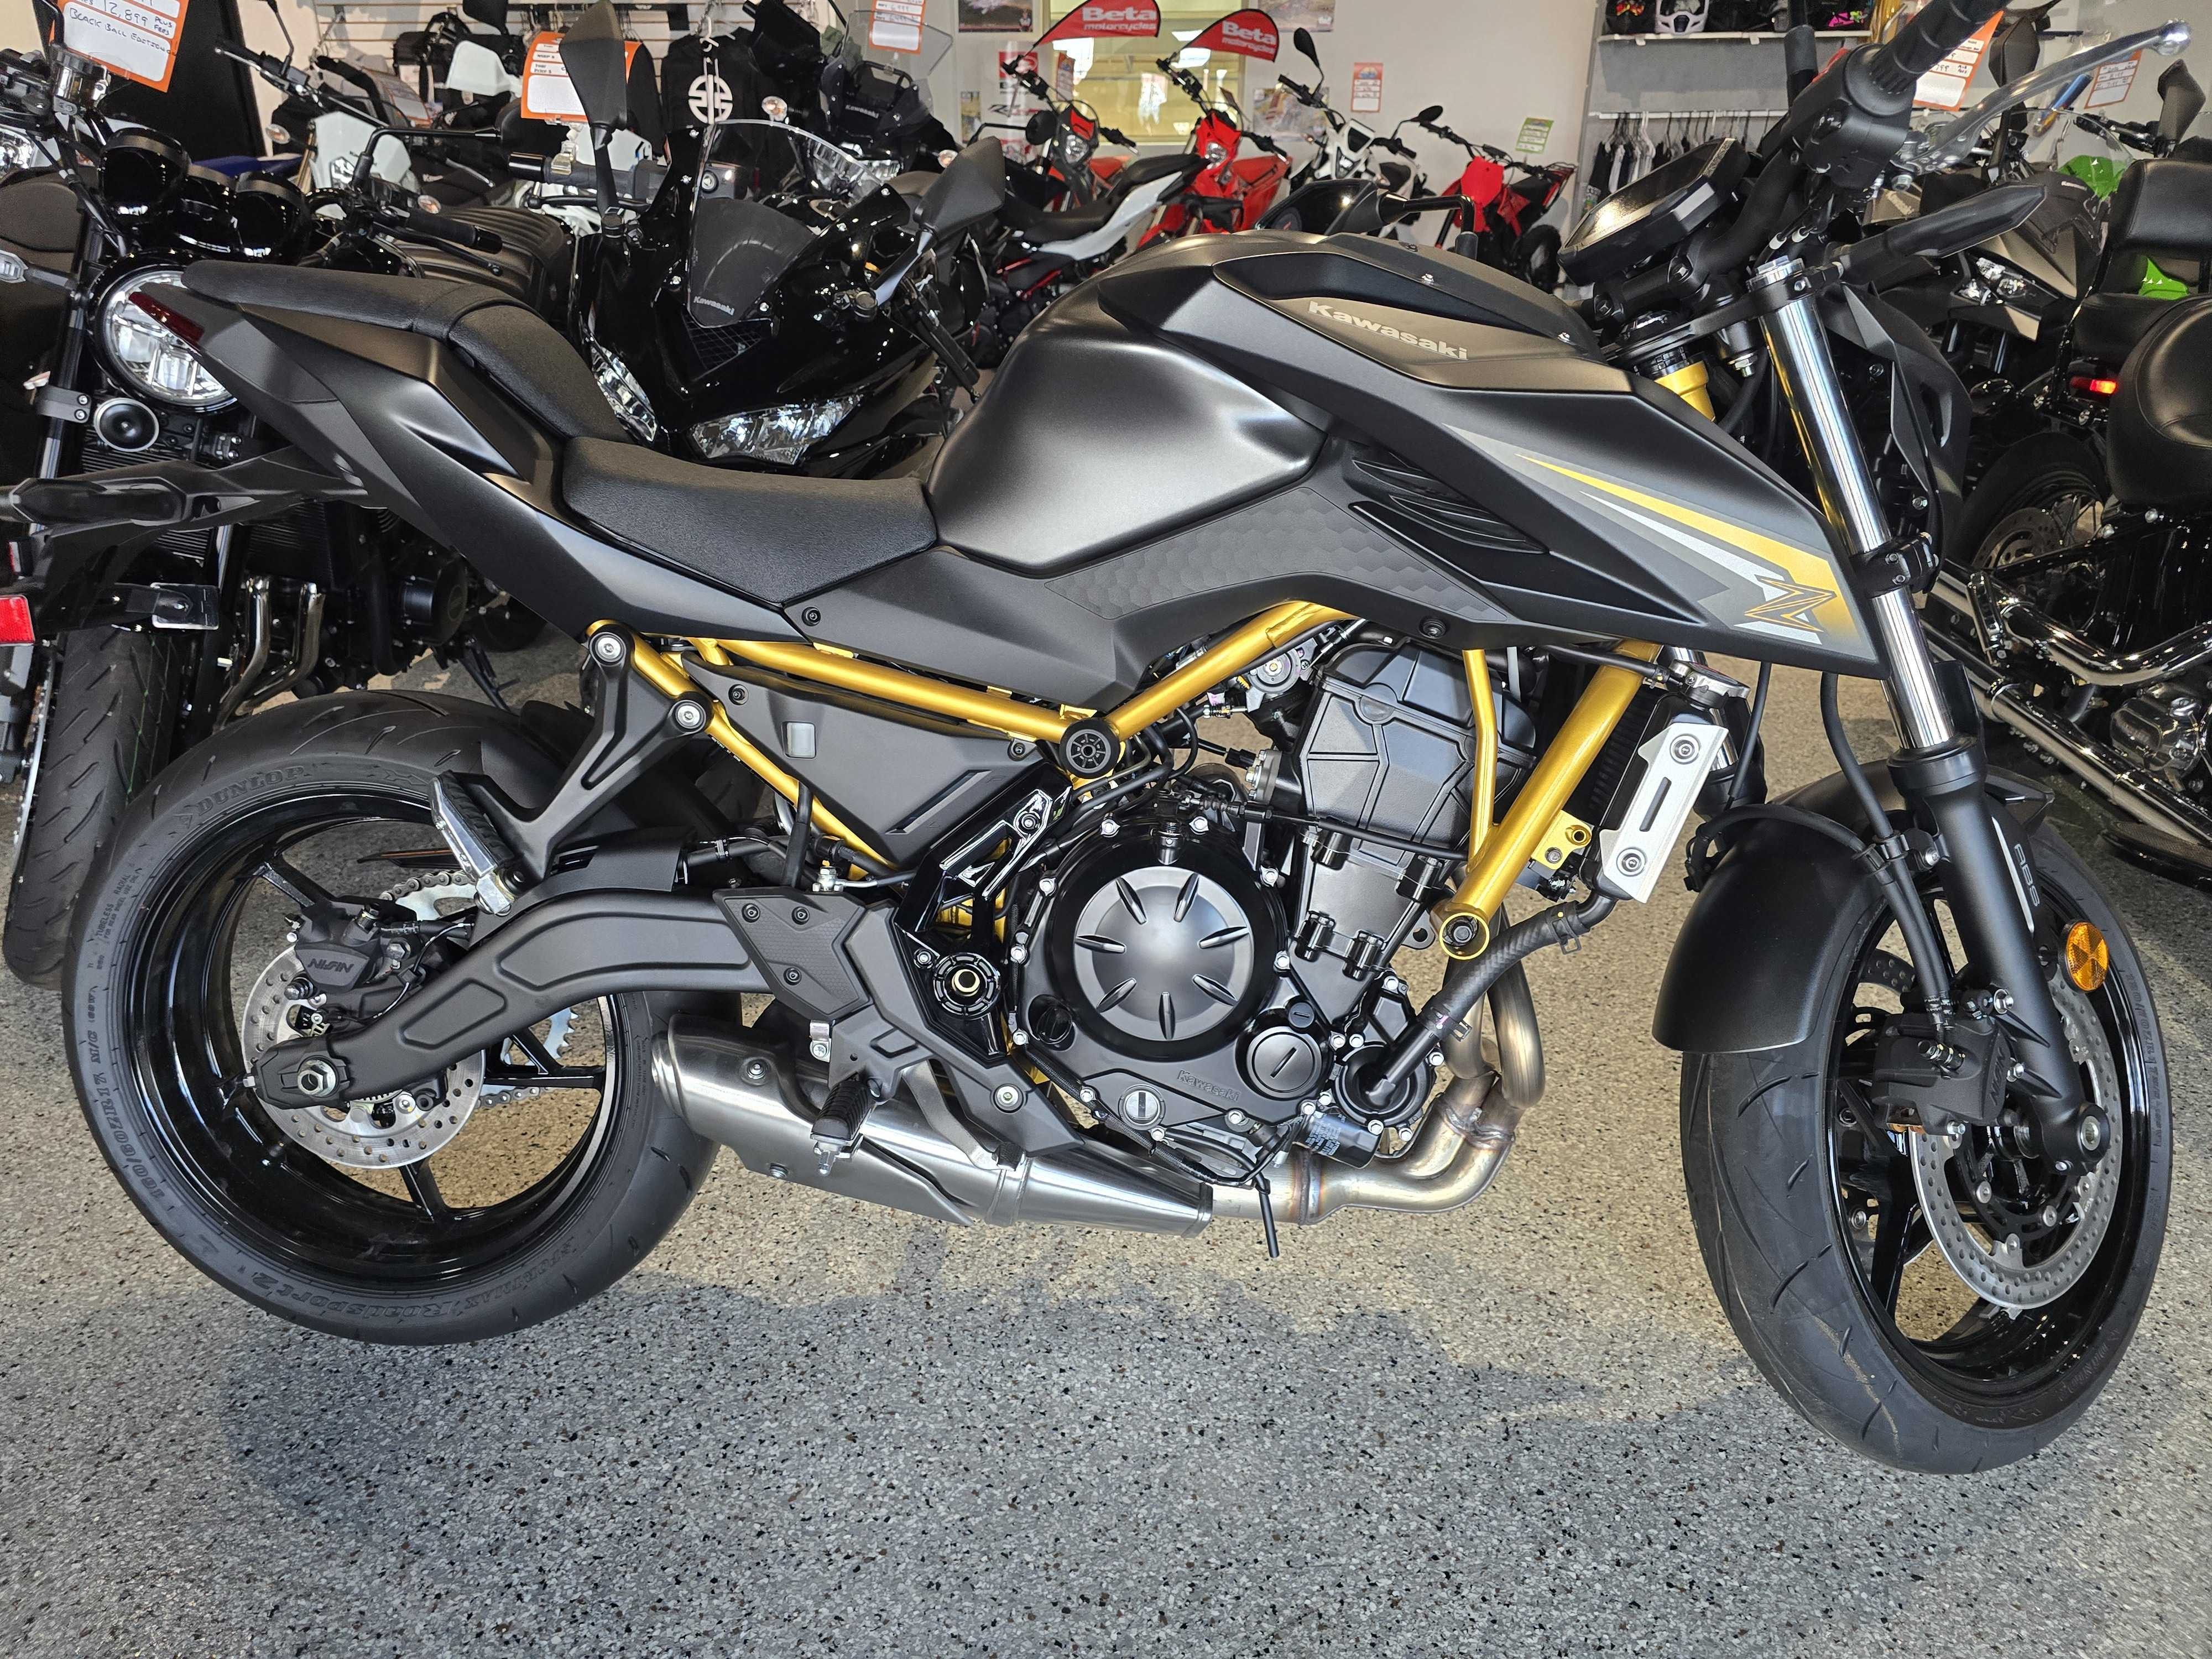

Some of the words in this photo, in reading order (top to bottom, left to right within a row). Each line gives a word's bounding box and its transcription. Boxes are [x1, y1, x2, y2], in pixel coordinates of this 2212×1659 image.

[1082, 6, 1157, 21] Beta
[1083, 23, 1157, 32] motorcycles
[1222, 20, 1277, 45] Beta
[845, 105, 879, 119] Kawasaki
[693, 296, 735, 316] Kawasaki
[1308, 300, 1468, 359] Kawasaki
[197, 765, 305, 816] DUNLOP
[2013, 843, 2040, 906] ABS
[95, 903, 114, 937] TUBELESS
[113, 874, 131, 895] RADIAL
[307, 958, 354, 973] NISSIN
[88, 1030, 102, 1064] M/C
[1177, 1069, 1241, 1102] Kawasaki
[253, 1272, 279, 1290] 2
[277, 1284, 455, 1318] Roadsport
